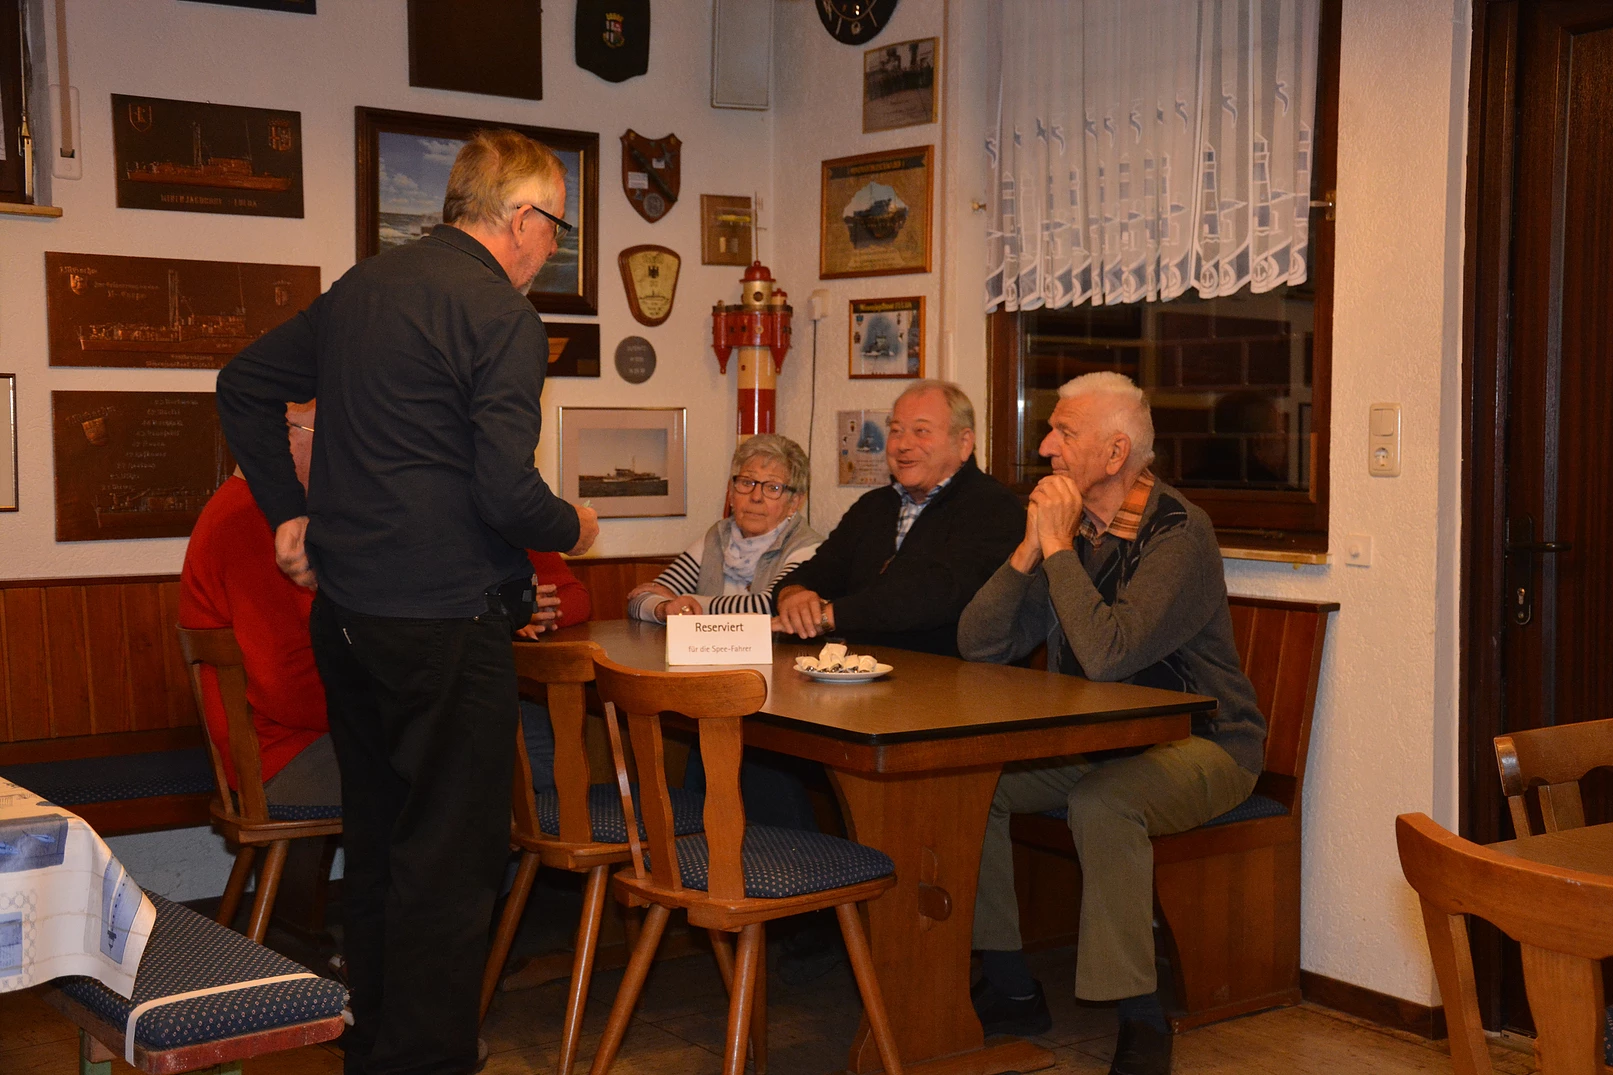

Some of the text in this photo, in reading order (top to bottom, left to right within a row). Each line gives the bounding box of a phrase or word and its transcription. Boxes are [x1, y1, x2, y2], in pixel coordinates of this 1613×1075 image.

[695, 622, 744, 632] Reserviert
[688, 645, 752, 654] für die Spee-Fahrer
